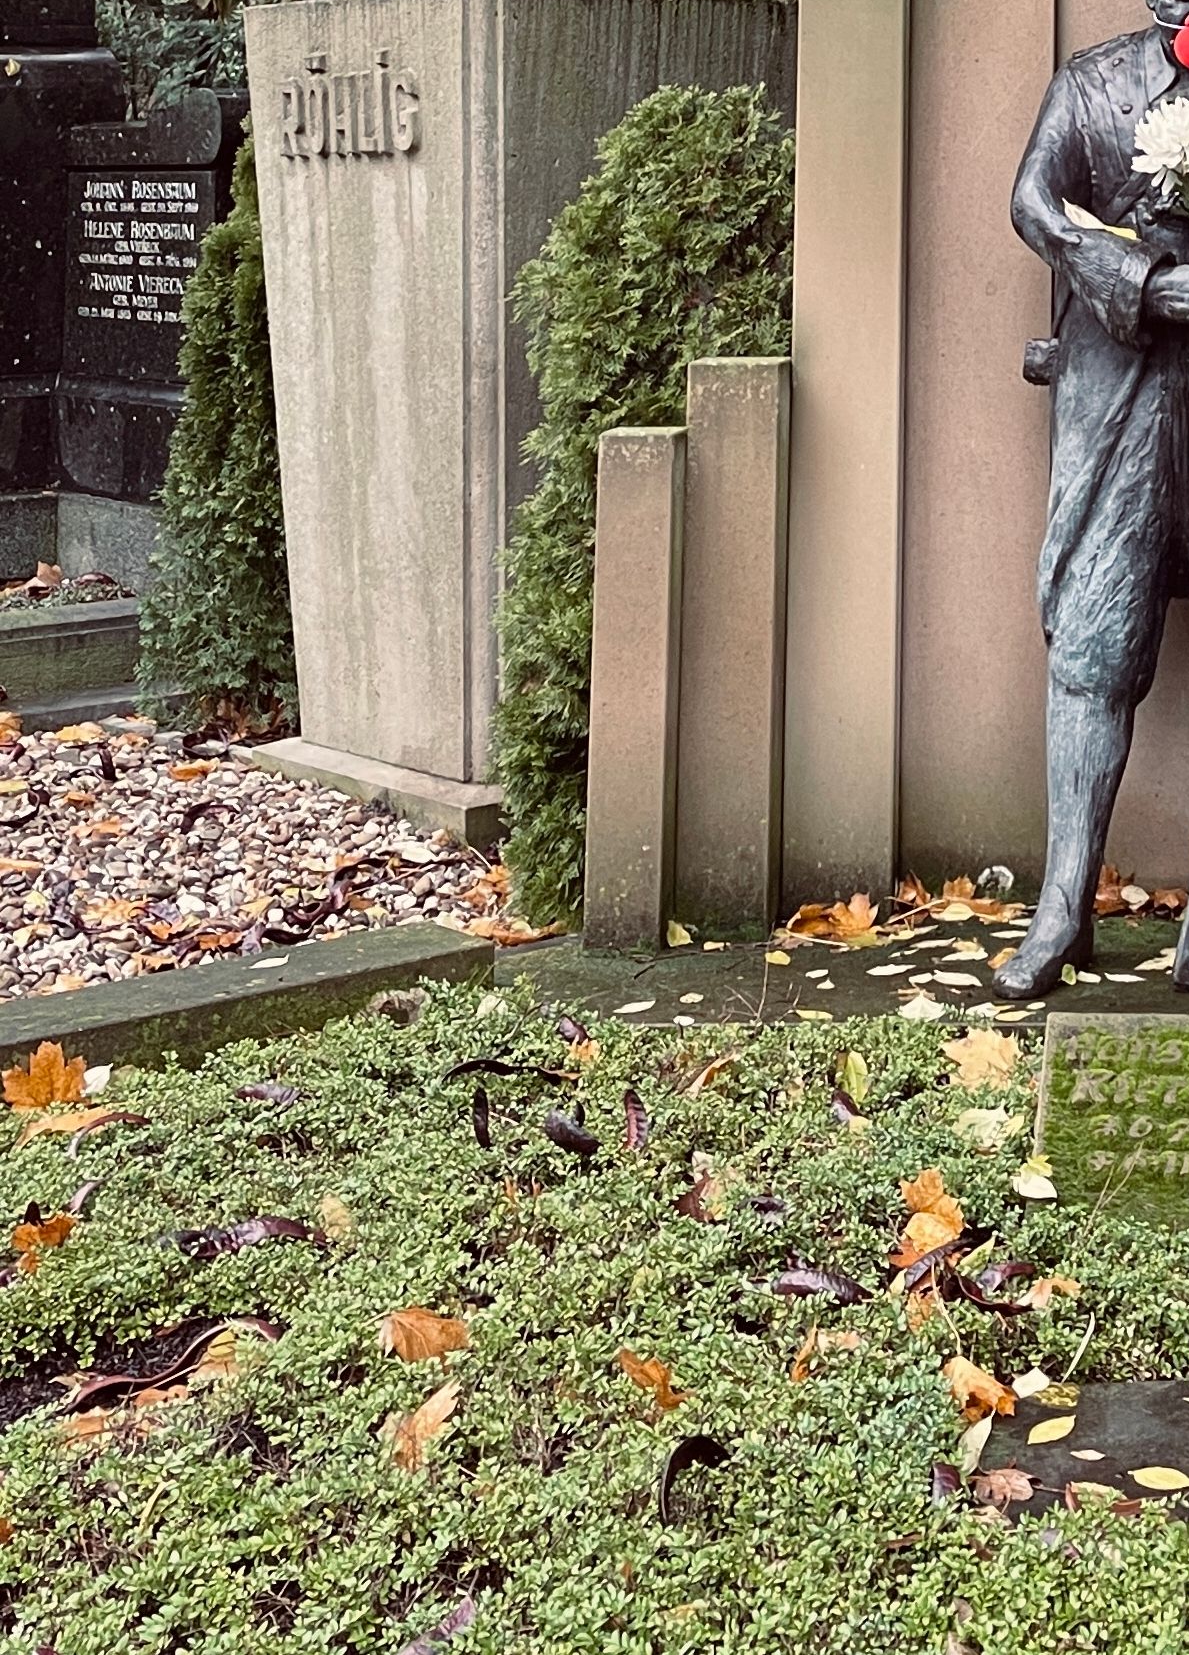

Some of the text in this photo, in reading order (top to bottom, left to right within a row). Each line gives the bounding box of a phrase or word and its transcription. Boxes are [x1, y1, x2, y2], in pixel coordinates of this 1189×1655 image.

[131, 180, 197, 200] ROSENBAUM
[84, 219, 195, 241] HELENE ROSENBAUM
[89, 271, 134, 293] ANTONIE
